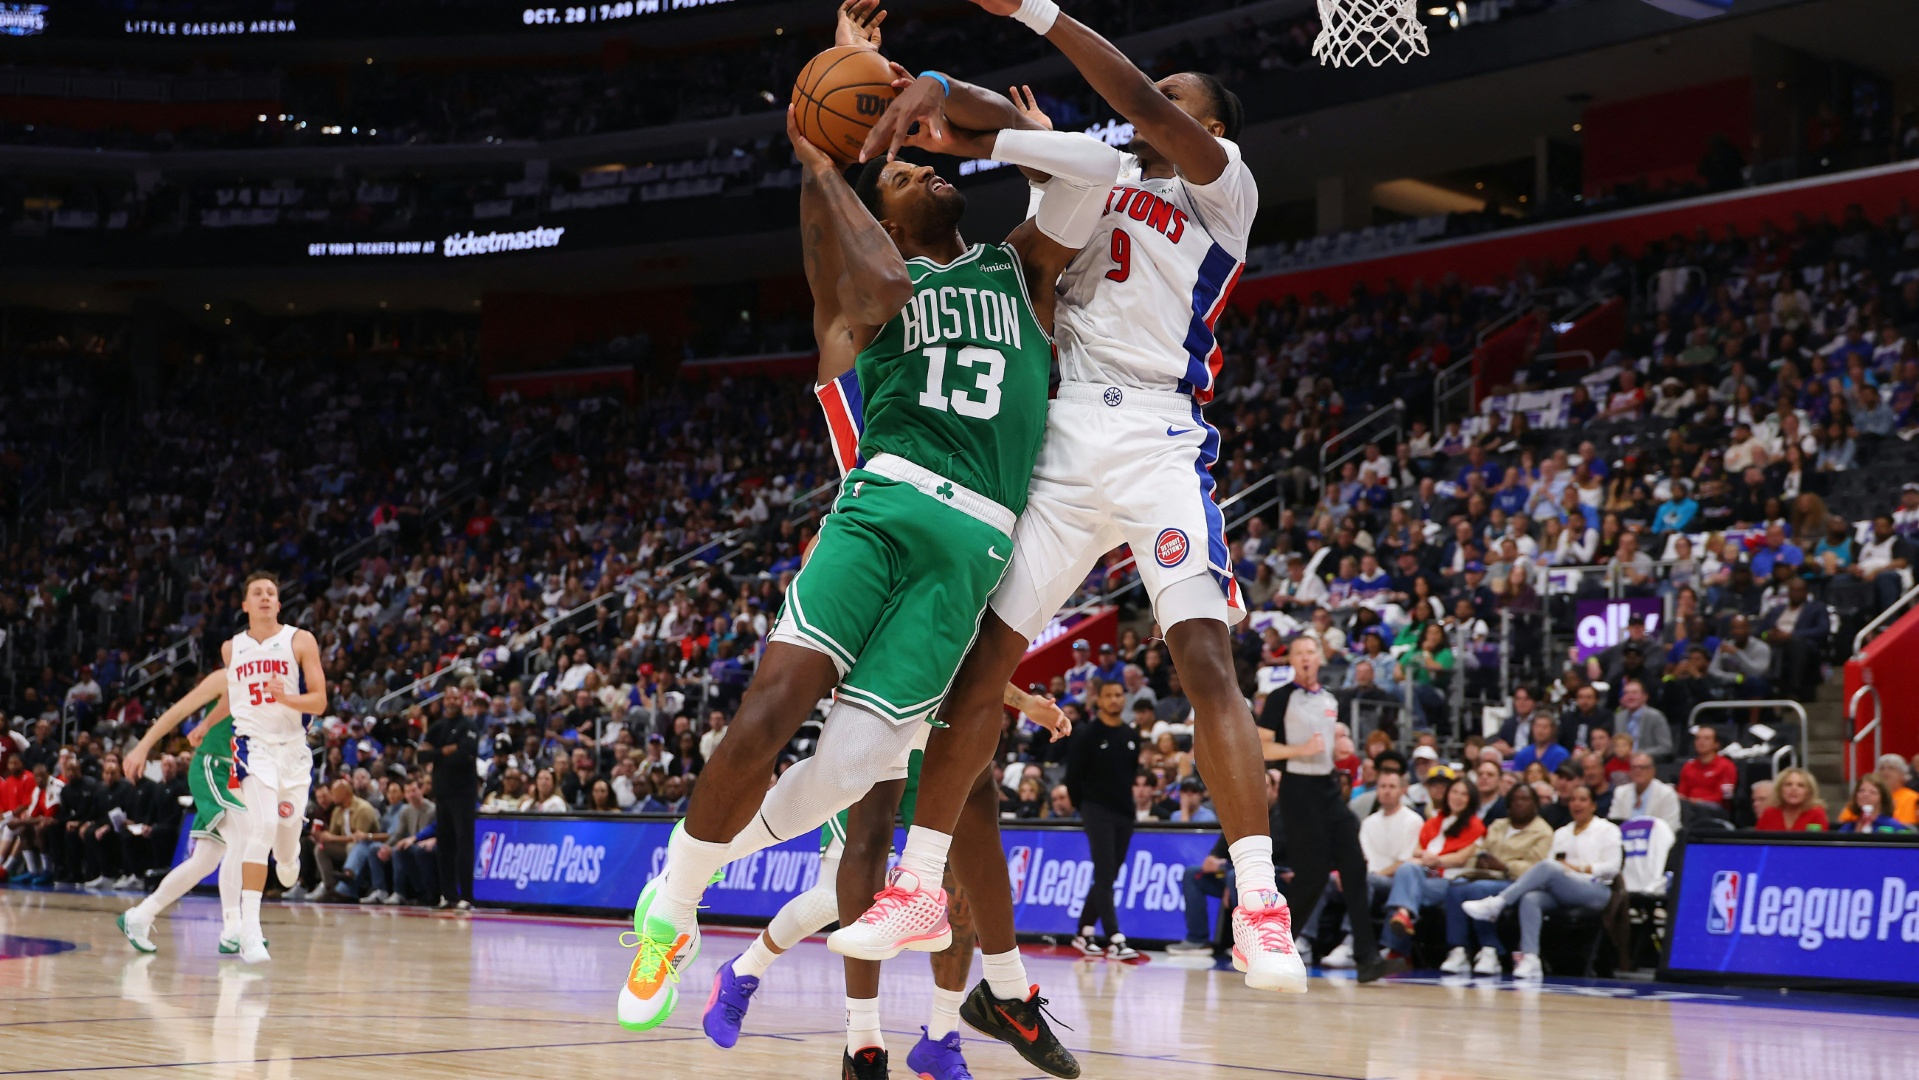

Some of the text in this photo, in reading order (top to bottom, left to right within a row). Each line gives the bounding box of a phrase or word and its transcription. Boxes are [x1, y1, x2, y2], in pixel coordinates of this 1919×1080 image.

[125, 19, 296, 35] LITTLE CAESARS ARENA
[523, 8, 561, 25] OCT.
[308, 243, 327, 256] GET
[328, 243, 354, 255] YOUR
[355, 242, 396, 254] TICKETS
[397, 241, 421, 254] NOW
[443, 226, 564, 257] ticketmaster
[1105, 228, 1131, 283] 9
[979, 261, 1012, 273] Amica
[901, 286, 1022, 354] BOSTON
[918, 343, 1006, 420] 13
[1160, 537, 1180, 551] DETROIT
[1162, 544, 1182, 557] PISTONS
[236, 660, 288, 681] PISTONS
[489, 832, 558, 890] League
[553, 835, 606, 884] Pass
[1024, 848, 1129, 918] Leage
[1740, 872, 1874, 950] League
